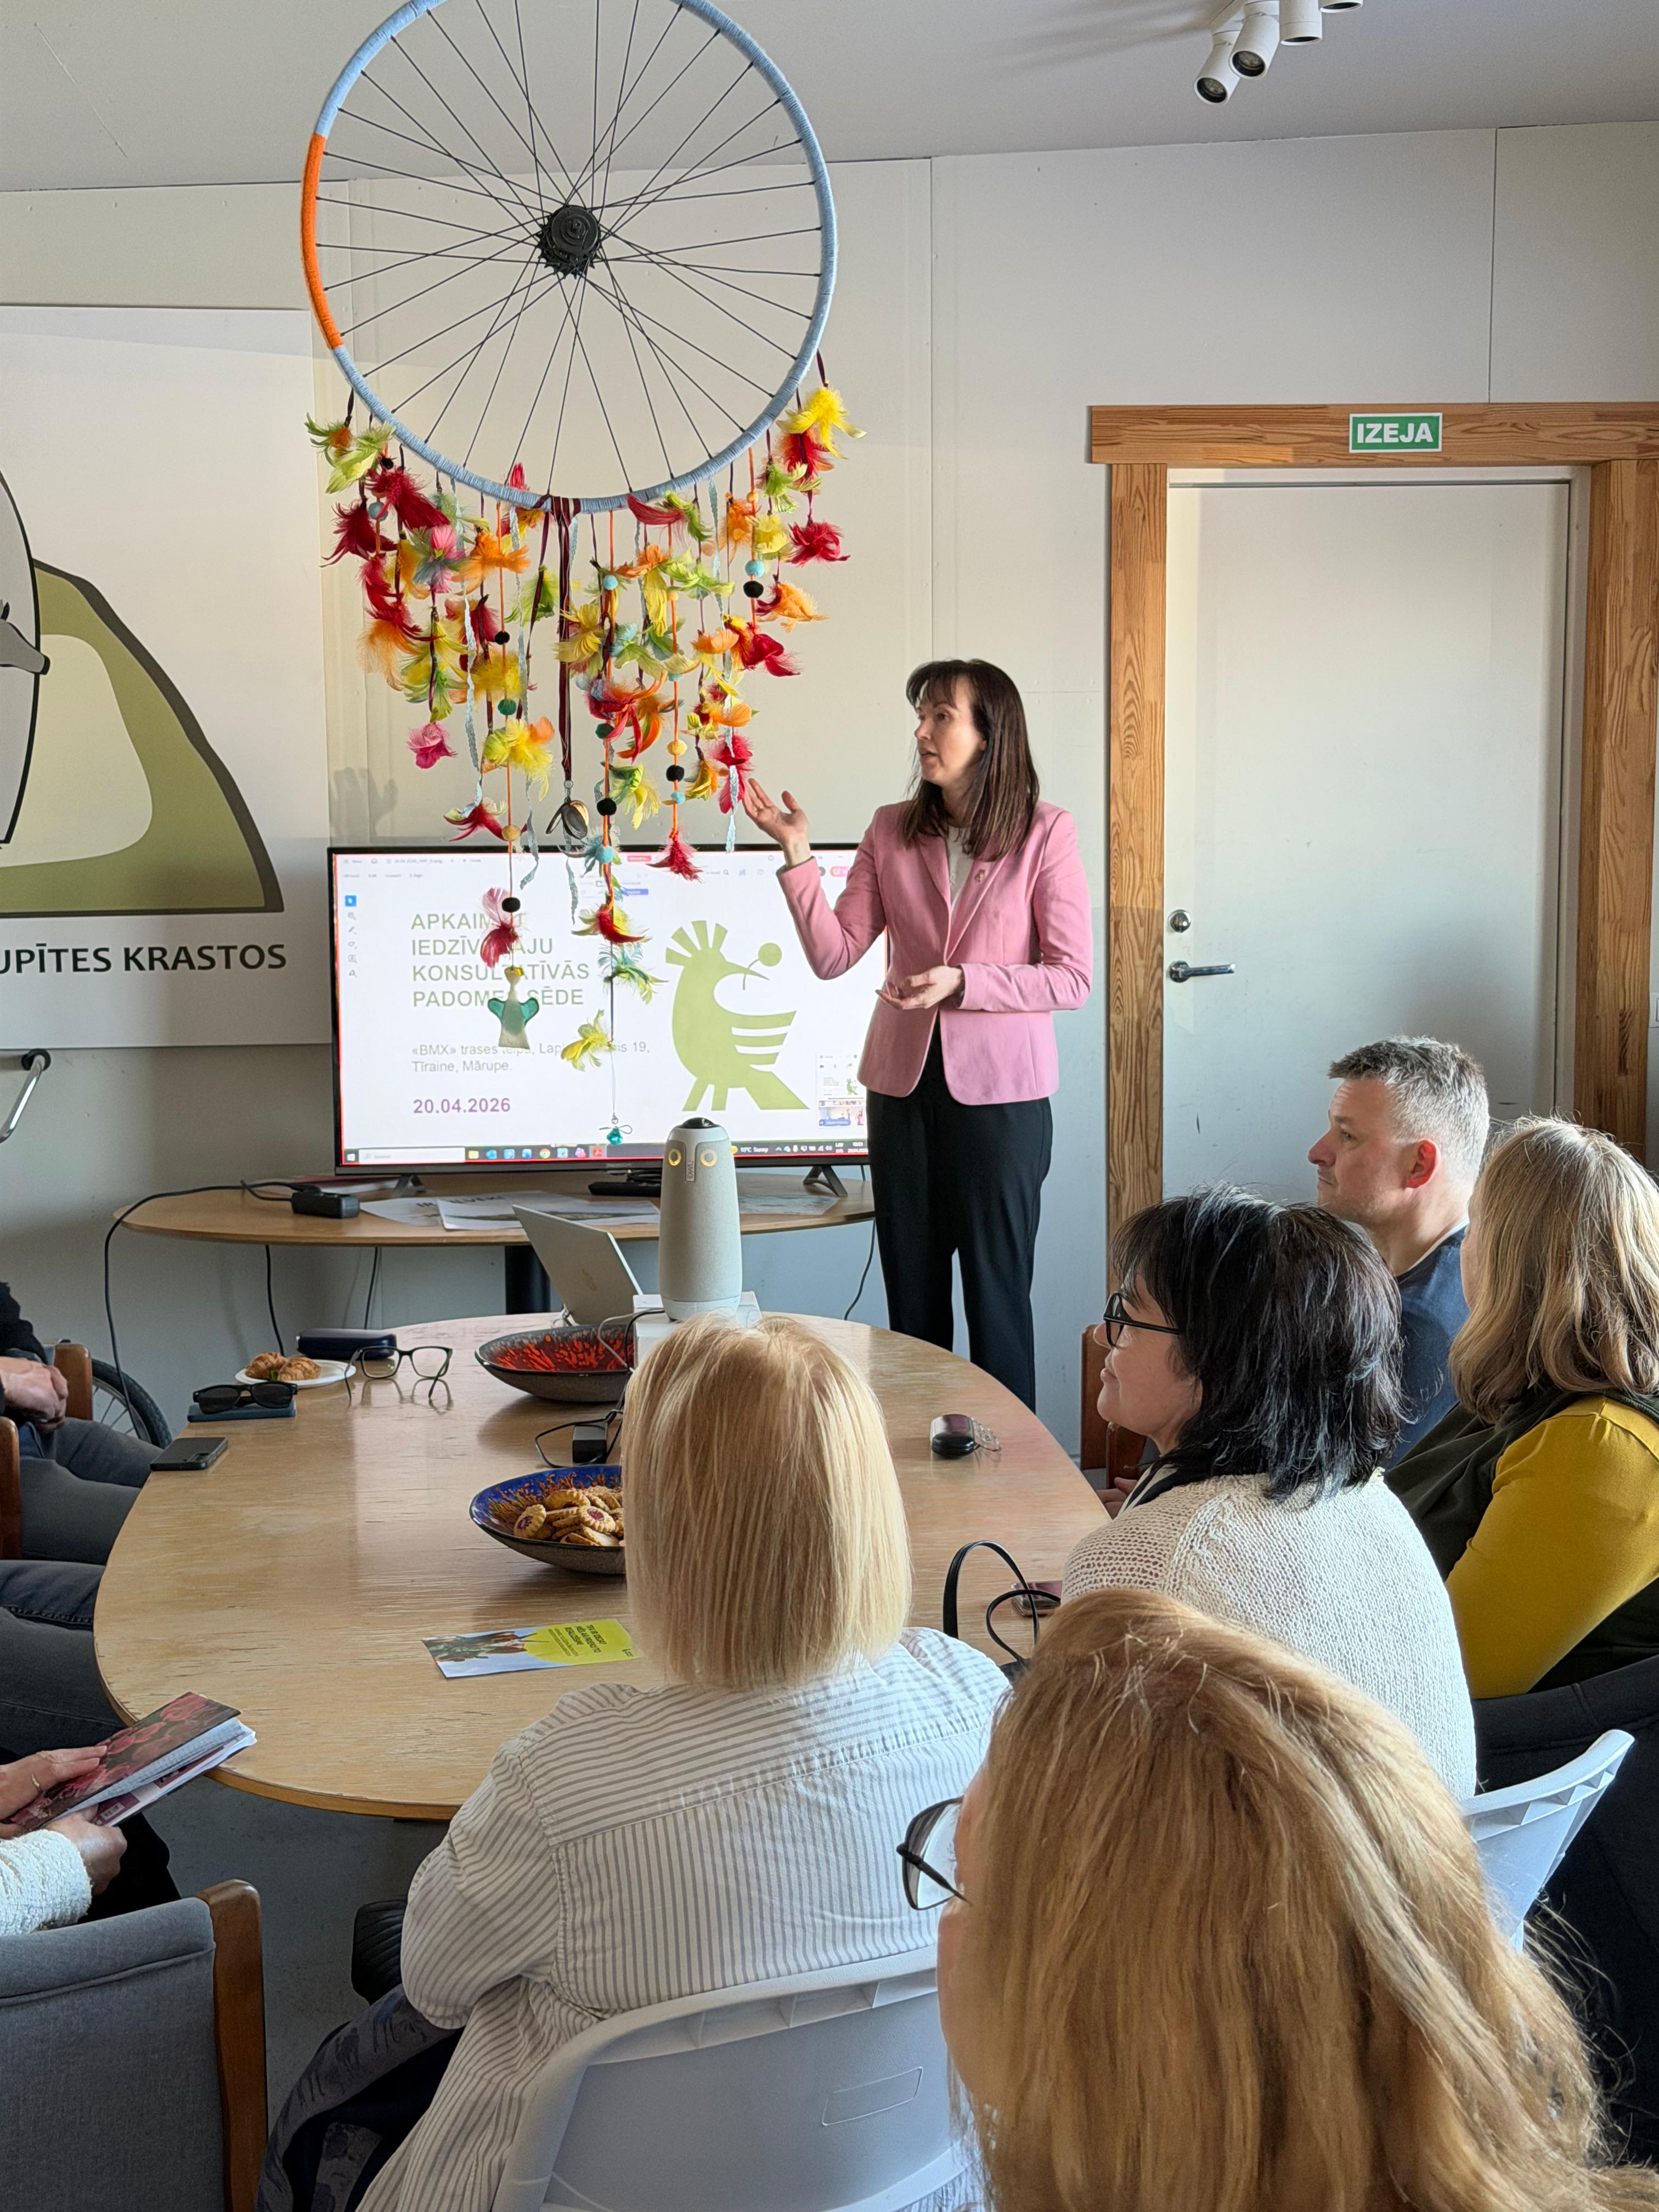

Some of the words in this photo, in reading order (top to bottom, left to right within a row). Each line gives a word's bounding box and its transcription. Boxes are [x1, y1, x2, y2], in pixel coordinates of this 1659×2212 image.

[1357, 422, 1434, 443] IZEJA
[412, 935, 552, 955] IEDZĪVJU
[123, 944, 287, 972] KRASTOS
[413, 961, 590, 981] KONSULTĪVĀS
[461, 1045, 498, 1054] trases
[413, 1098, 511, 1114] 20.04.2026
